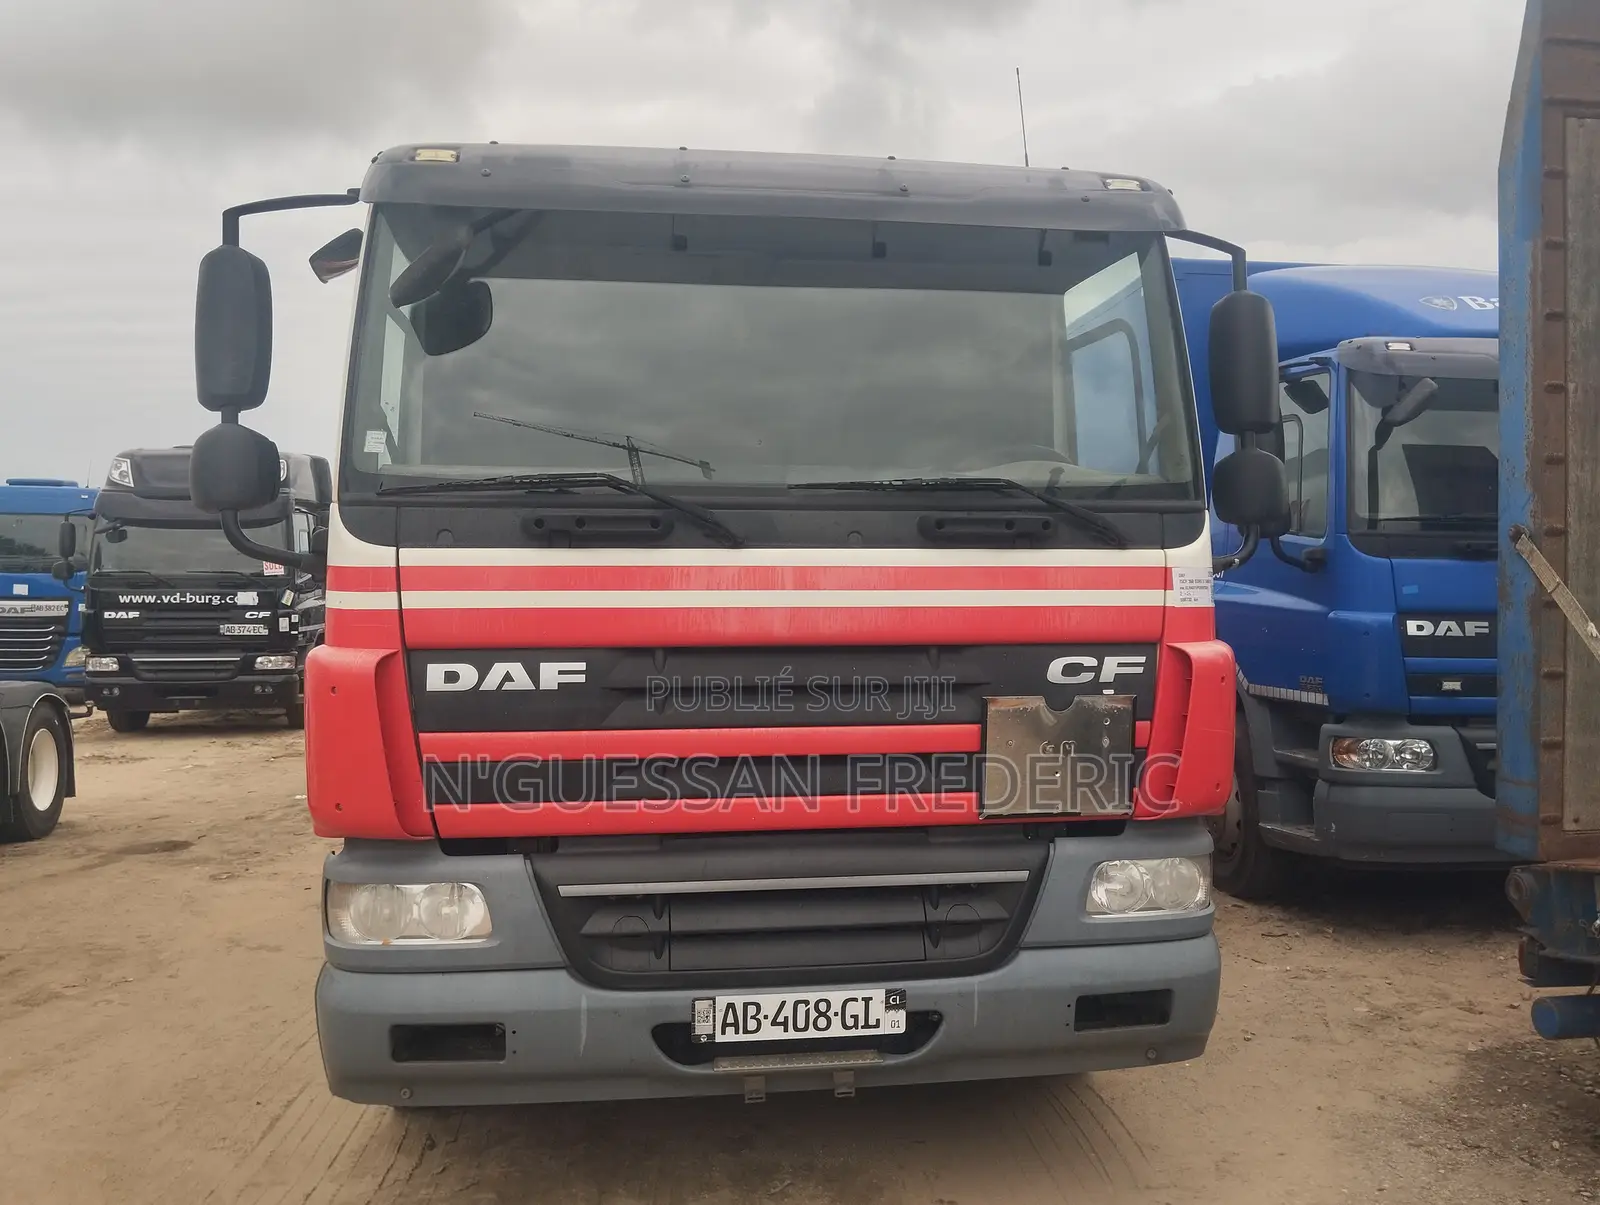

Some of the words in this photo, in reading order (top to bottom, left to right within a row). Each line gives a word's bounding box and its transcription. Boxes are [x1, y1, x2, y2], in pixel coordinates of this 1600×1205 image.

[118, 592, 259, 606] www.vd-burg.c
[104, 611, 140, 619] DAF
[245, 611, 271, 619] CF
[1406, 619, 1490, 637] DAF
[1046, 656, 1146, 684] CF
[425, 661, 587, 692] DAF
[889, 995, 901, 1005] CI
[890, 1019, 901, 1029] 01
